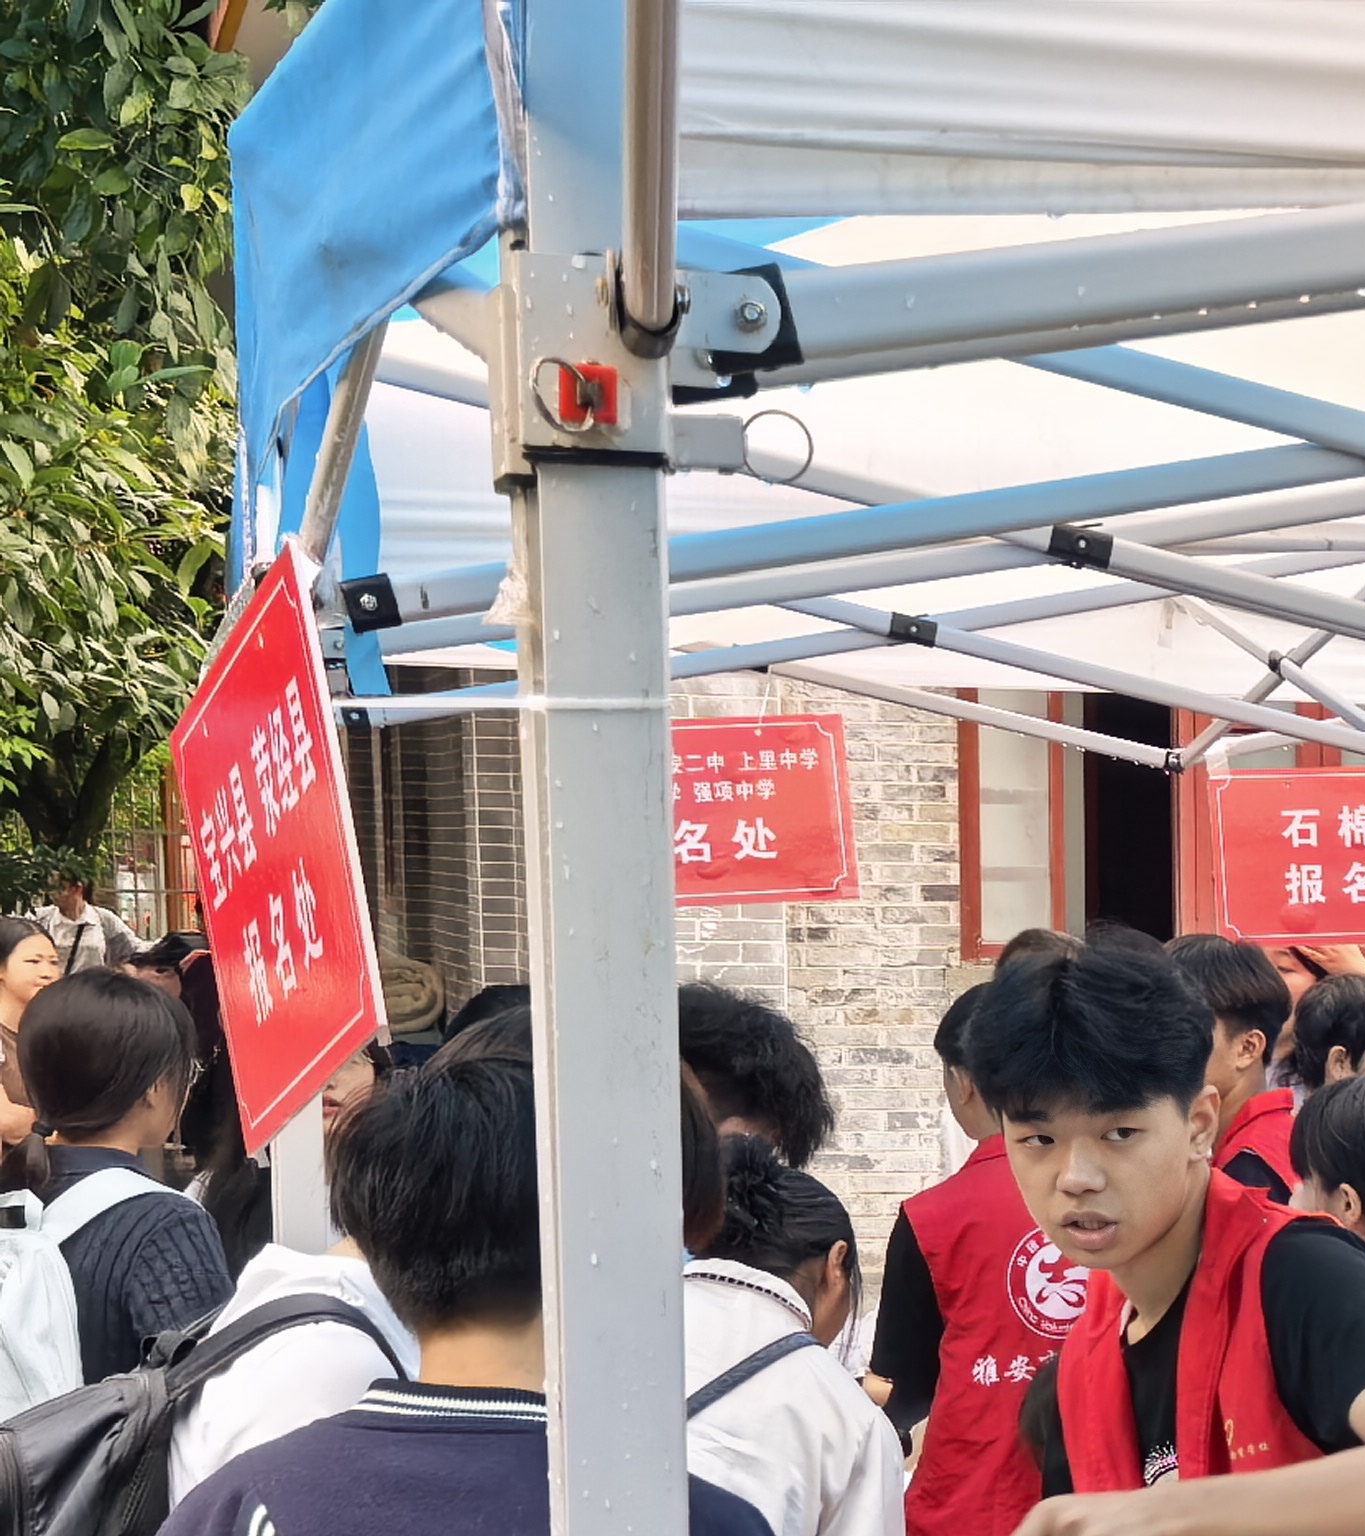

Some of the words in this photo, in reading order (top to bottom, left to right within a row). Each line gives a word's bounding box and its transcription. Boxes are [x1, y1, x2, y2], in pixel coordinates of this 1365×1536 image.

[738, 748, 819, 771] 上里中学
[200, 761, 257, 911] 宝兴县
[242, 857, 323, 1027] 报名处
